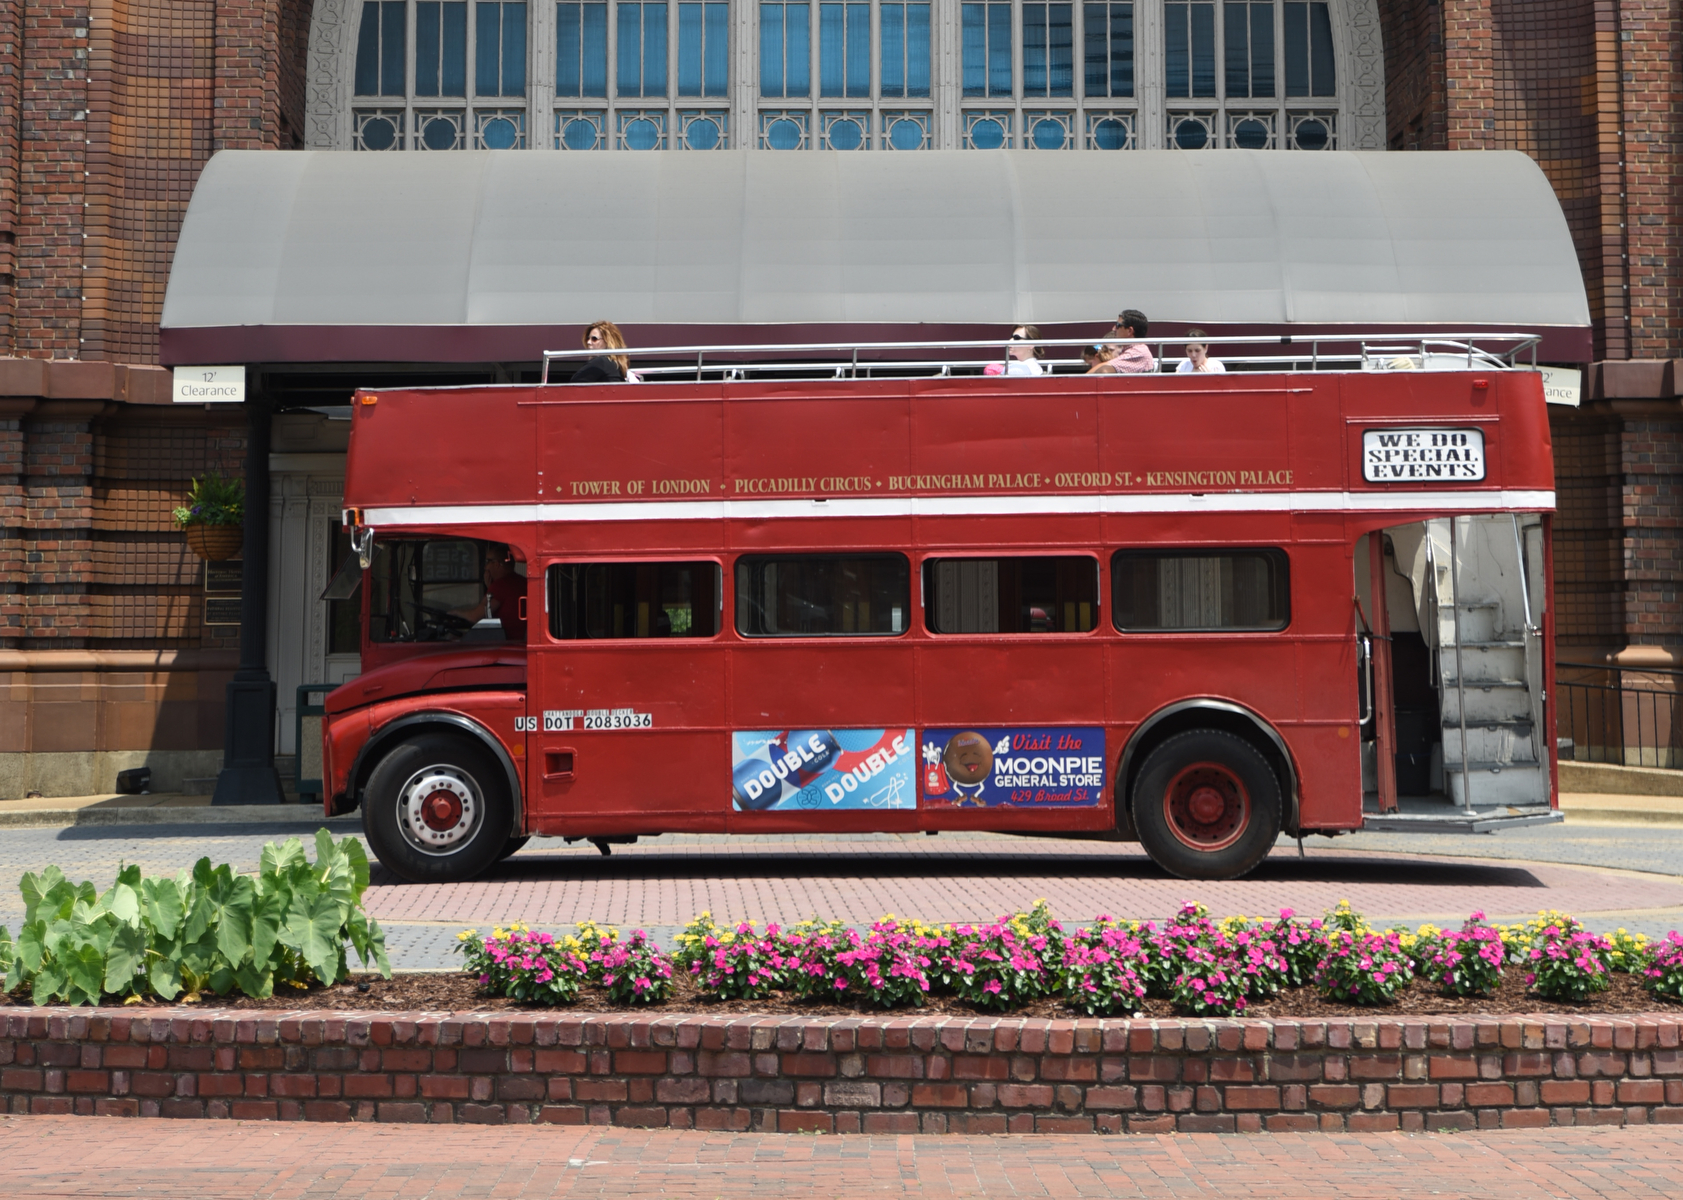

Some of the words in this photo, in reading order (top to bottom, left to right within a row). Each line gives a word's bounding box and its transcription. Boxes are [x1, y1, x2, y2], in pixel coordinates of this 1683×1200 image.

[201, 371, 217, 383] 12'
[1542, 372, 1553, 384] 2'
[181, 385, 237, 396] Clearance
[1377, 433, 1420, 447] WE
[1430, 433, 1468, 447] DO
[1368, 448, 1478, 462] SPECIAL
[1372, 464, 1477, 478] EVENTS
[570, 480, 621, 495] TOWER
[627, 480, 645, 494] OF
[652, 479, 710, 494] LONDON
[734, 478, 817, 493] PICCADILLY
[820, 476, 872, 492] CIRCUS
[888, 474, 984, 491] BUCKINGHAM
[988, 473, 1041, 488] PALACE
[1054, 472, 1111, 487] OXFORD
[1115, 472, 1133, 486] ST.
[1146, 470, 1236, 486] KENSINGTON
[1240, 470, 1294, 485] PALACE
[586, 709, 609, 717] DOUBLE
[611, 708, 633, 716] DECKER
[515, 716, 536, 730] US
[545, 717, 572, 730] DOT
[585, 714, 651, 729] 2083036
[1012, 733, 1051, 751] Visit
[1056, 733, 1082, 751] the
[743, 733, 827, 801] DOUBLE
[824, 734, 911, 805] DOUBLE
[994, 756, 1103, 775] MOONPIE
[994, 774, 1057, 787] GENERAL
[1059, 773, 1102, 786] STORE
[1011, 789, 1032, 802] 429
[1035, 788, 1071, 803] Broad
[1073, 788, 1089, 802] St.
